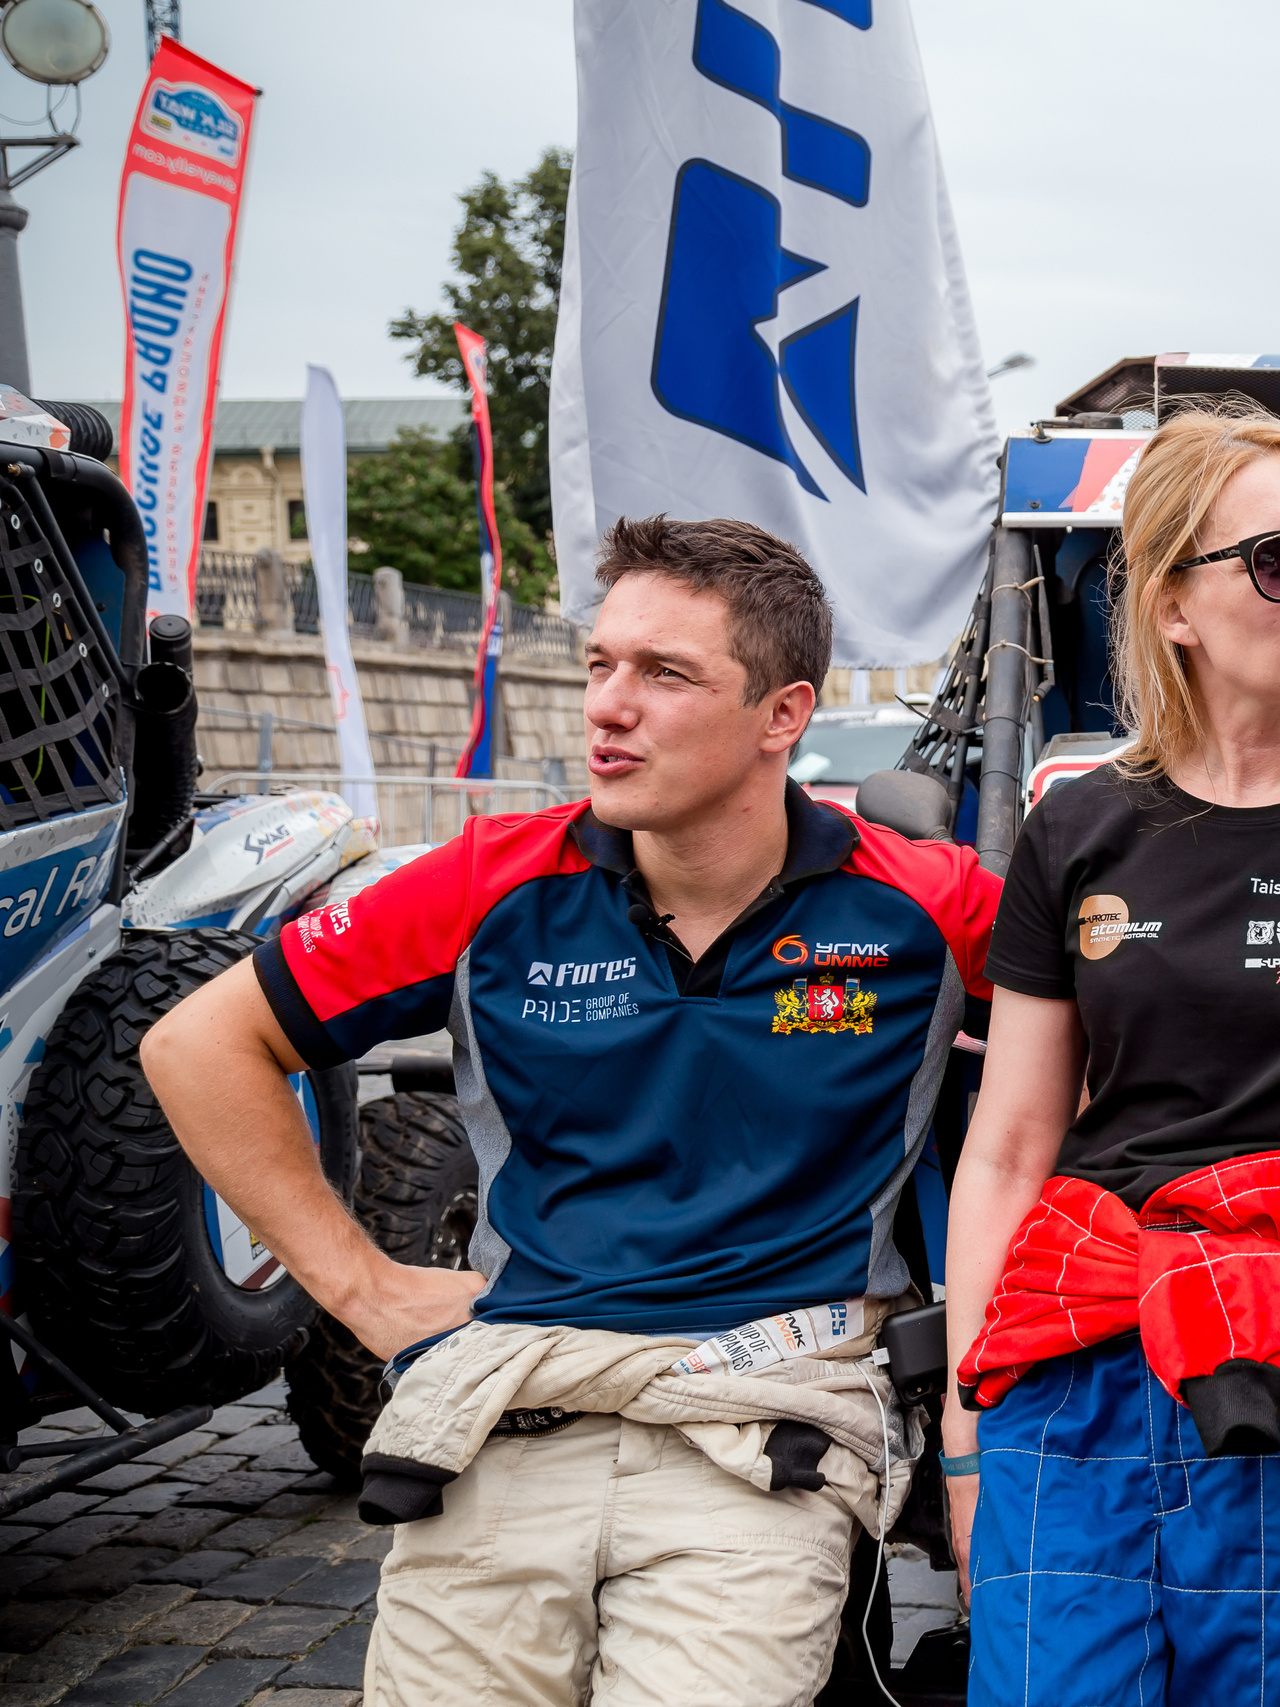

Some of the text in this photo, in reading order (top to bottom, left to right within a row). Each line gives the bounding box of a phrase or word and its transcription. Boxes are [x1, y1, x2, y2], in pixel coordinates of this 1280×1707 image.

[1089, 935, 1121, 944] SYNTHETIC
[1121, 931, 1146, 940] MOTOR
[815, 942, 890, 957] УГМК
[813, 953, 889, 968] UMMC
[521, 991, 630, 1023] PRIDE GROUP OF
[585, 1002, 640, 1022] COMPANIES
